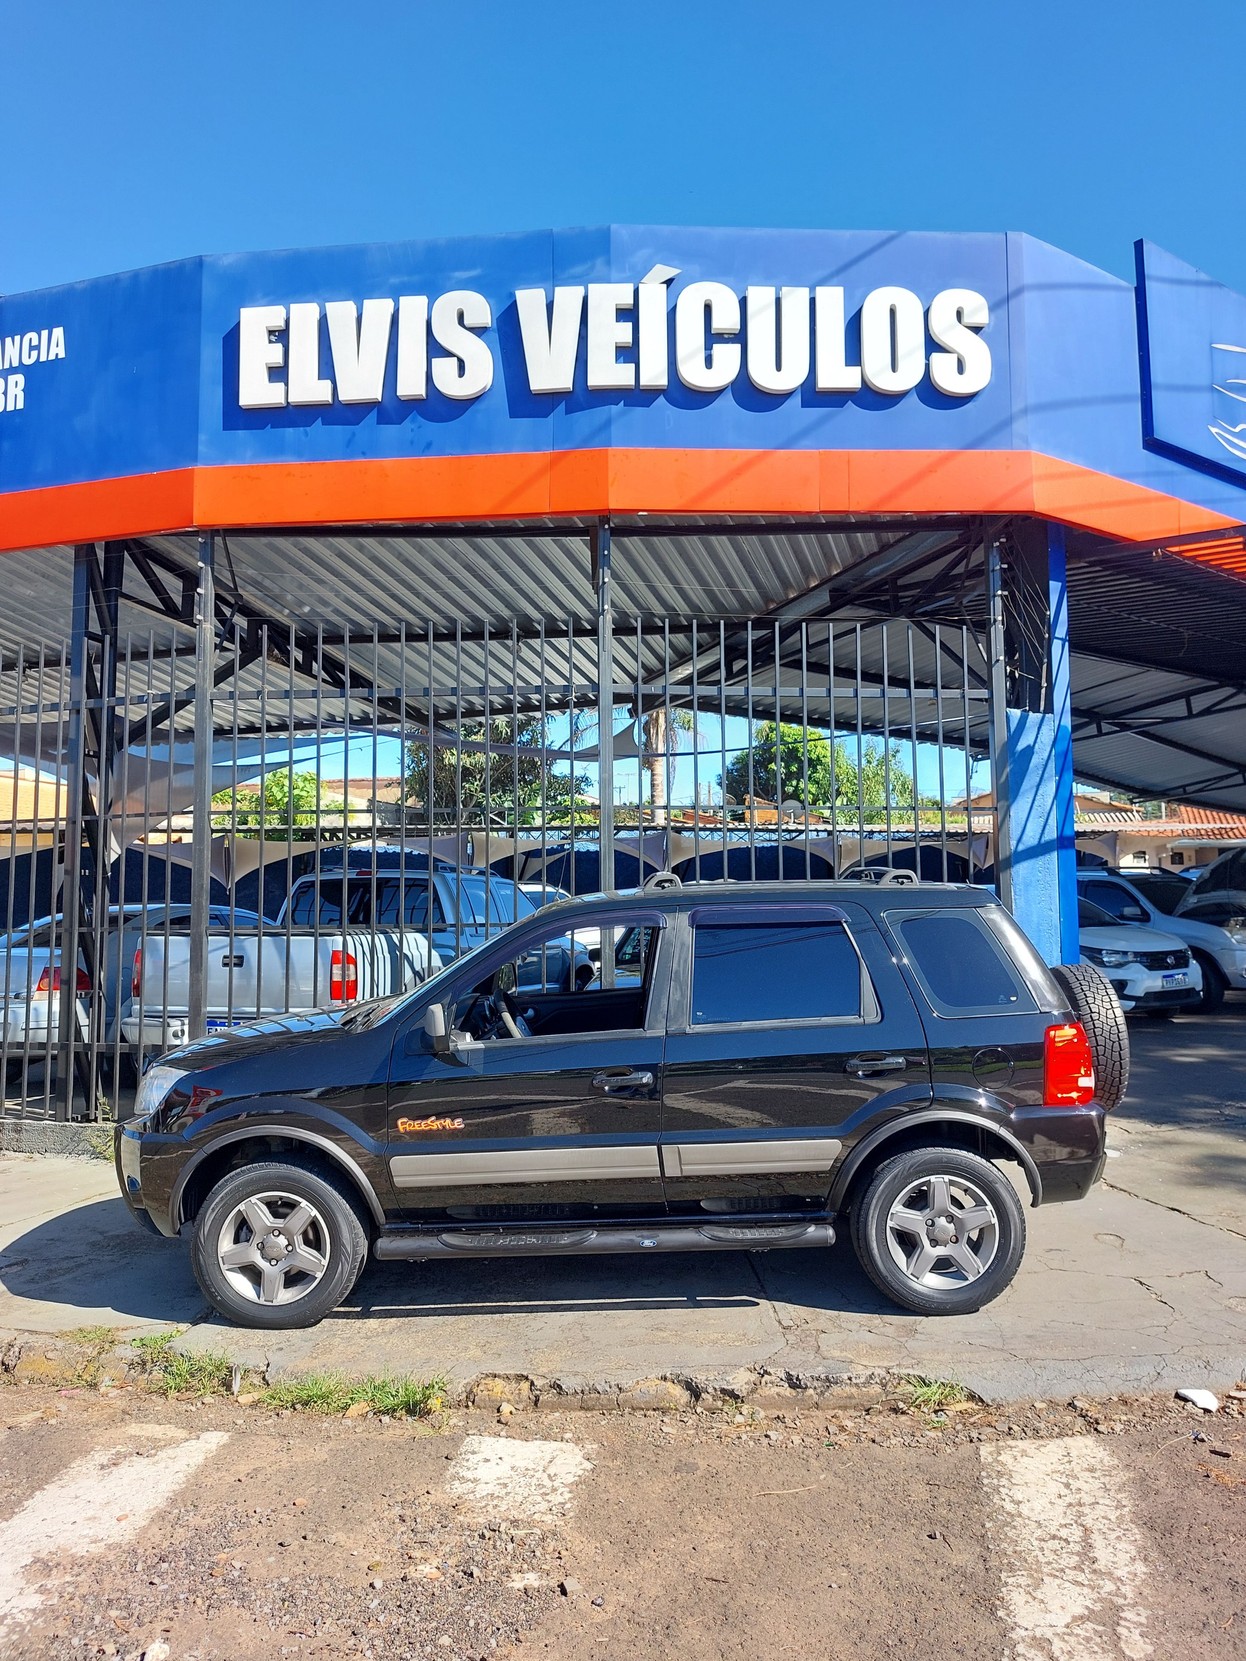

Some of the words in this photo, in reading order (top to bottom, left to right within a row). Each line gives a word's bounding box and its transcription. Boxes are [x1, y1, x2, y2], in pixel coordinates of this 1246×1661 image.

[0, 326, 66, 370] NCIA
[238, 290, 494, 409] ELVIS
[515, 263, 992, 397] VEÍCULOS
